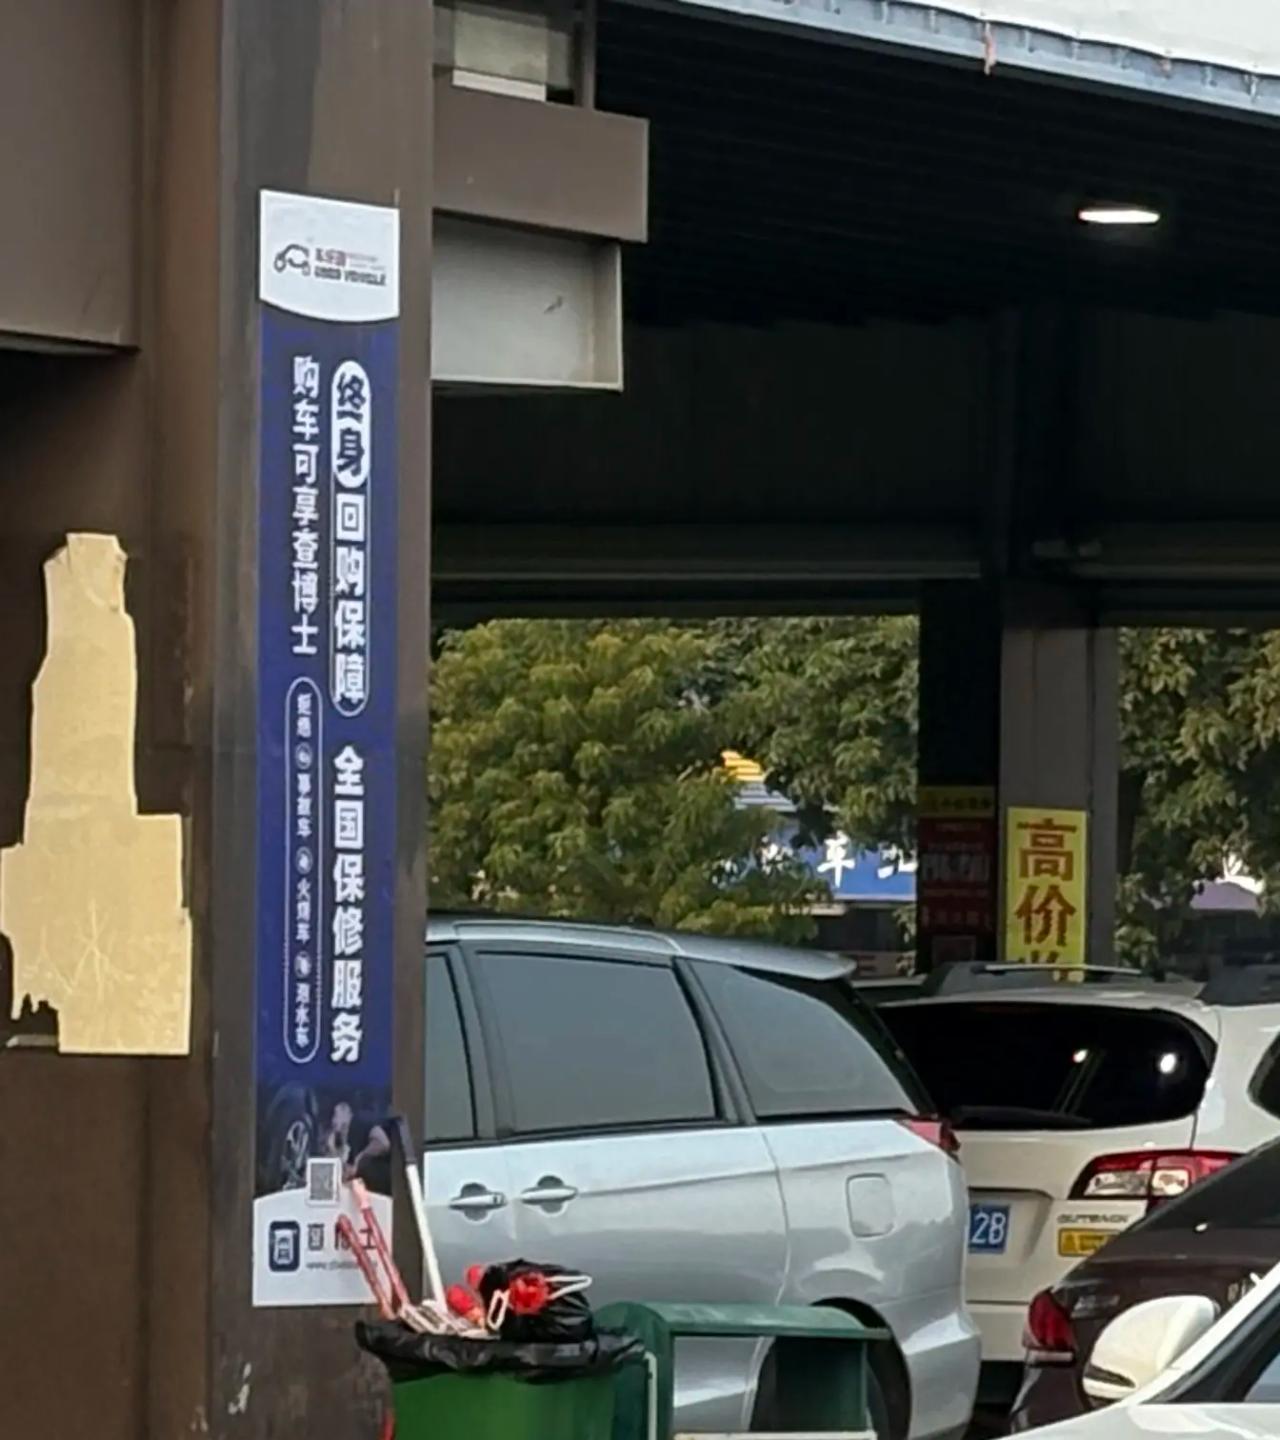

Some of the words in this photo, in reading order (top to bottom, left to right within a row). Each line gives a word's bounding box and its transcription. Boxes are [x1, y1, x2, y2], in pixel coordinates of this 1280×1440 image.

[292, 355, 320, 655] 购车可享查博士
[336, 371, 367, 705] 终身回购保障
[330, 745, 364, 1063] 全国保修服务
